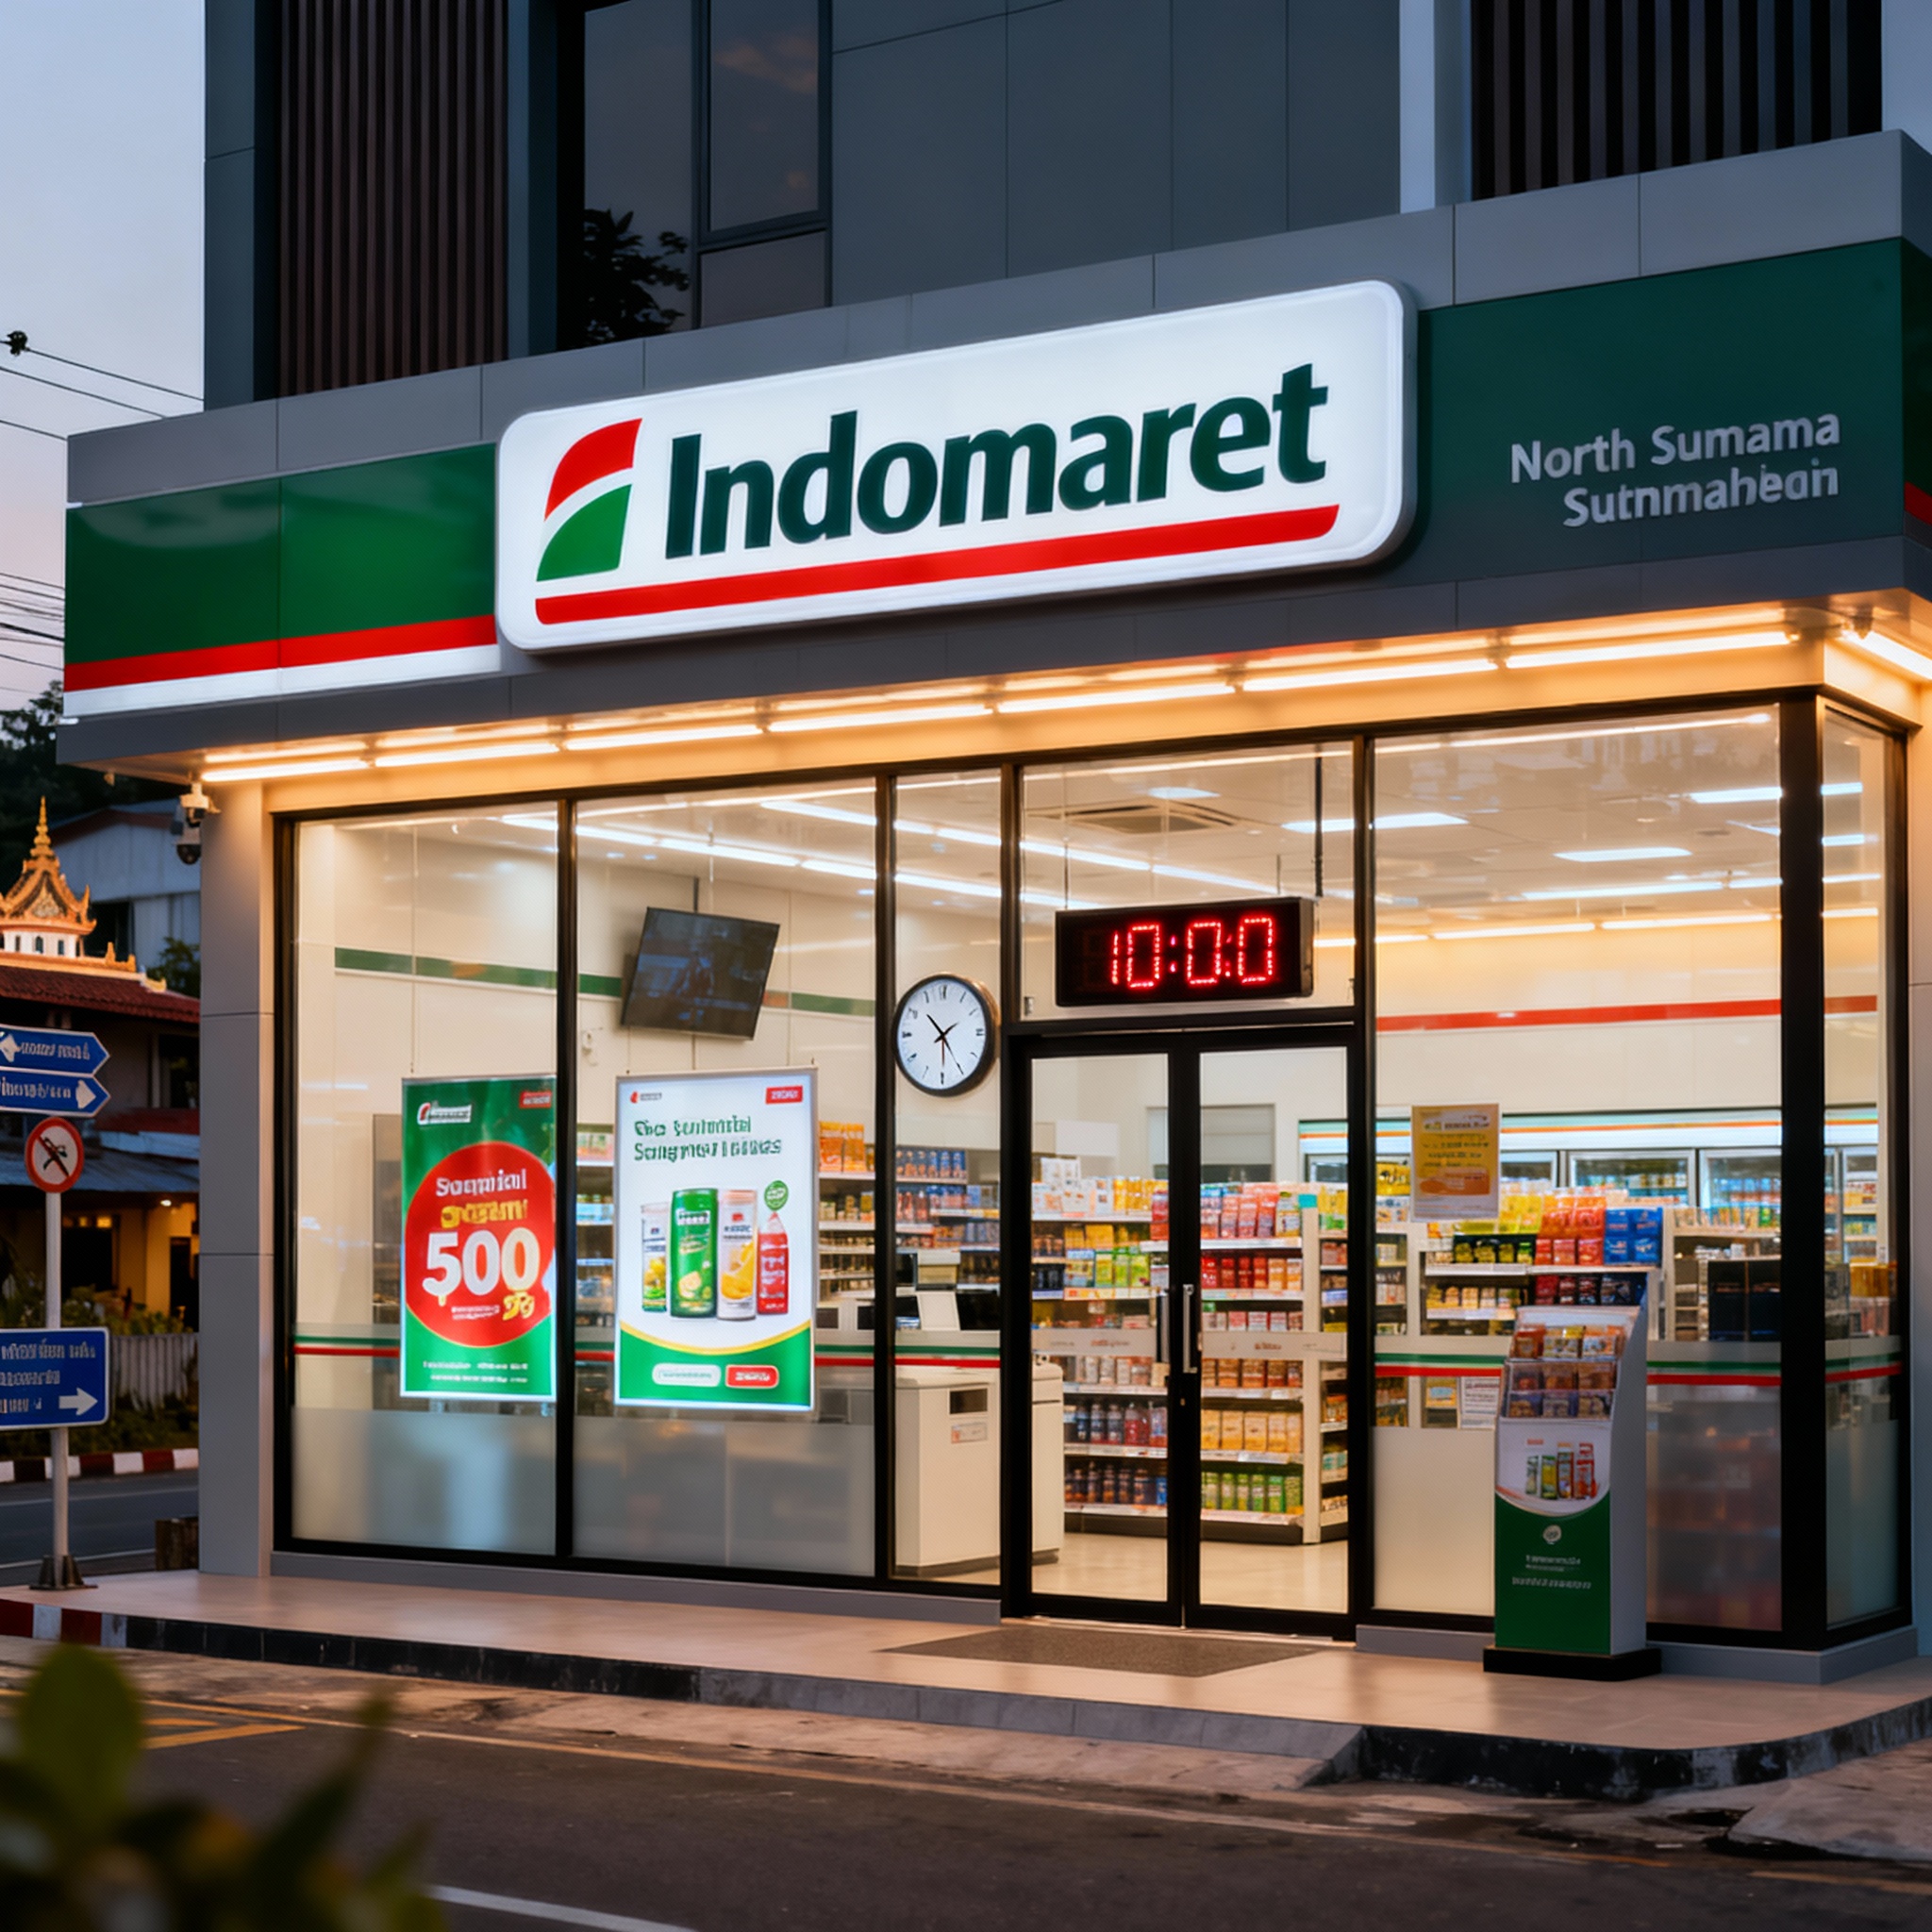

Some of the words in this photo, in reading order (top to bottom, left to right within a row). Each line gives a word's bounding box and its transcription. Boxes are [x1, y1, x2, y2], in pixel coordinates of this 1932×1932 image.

[665, 363, 1329, 559] Indomaret
[1511, 428, 1636, 483] North
[1651, 413, 1840, 466] Sumama
[422, 1227, 541, 1307] 500
